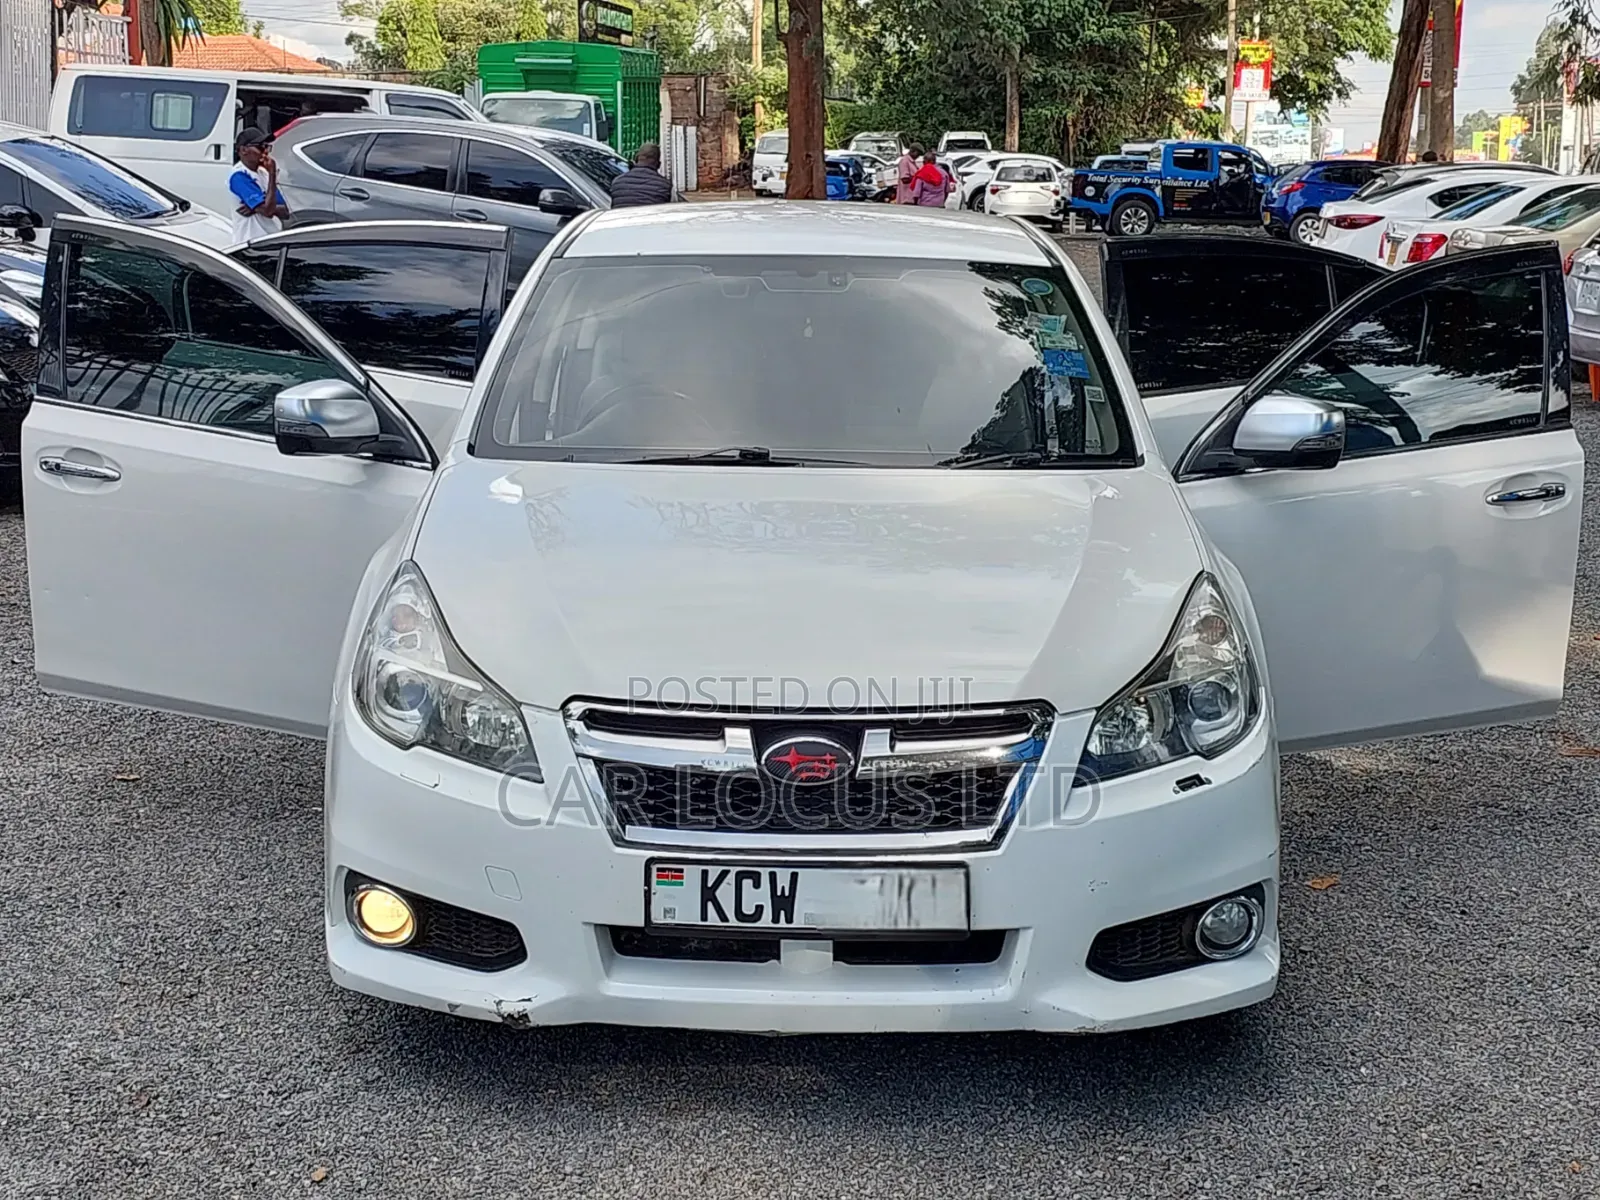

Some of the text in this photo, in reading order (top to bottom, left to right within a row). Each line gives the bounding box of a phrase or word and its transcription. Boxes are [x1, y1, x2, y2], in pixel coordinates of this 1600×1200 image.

[1087, 173, 1108, 183] Total
[1108, 174, 1142, 185] Security
[1143, 175, 1193, 187] Surveillance
[700, 868, 799, 924] KCW
